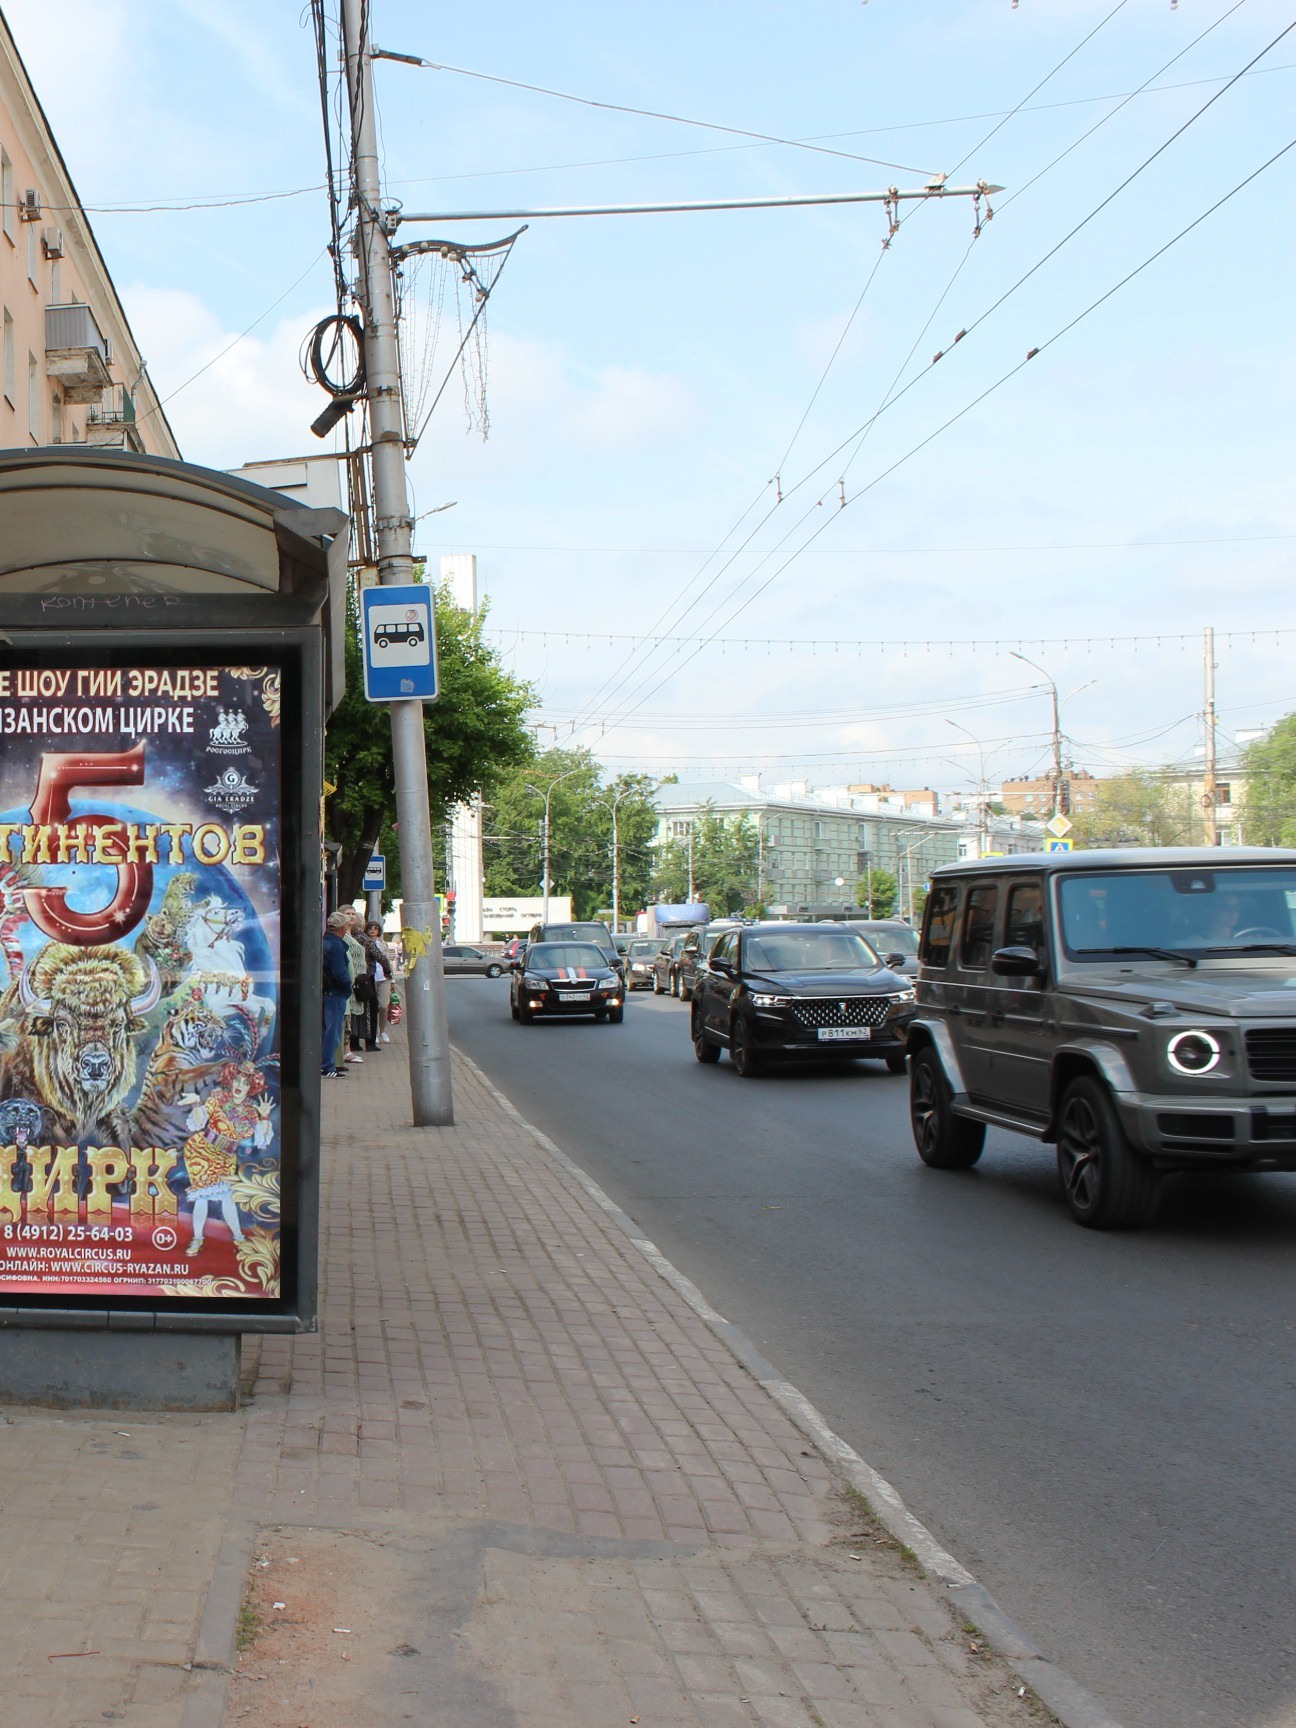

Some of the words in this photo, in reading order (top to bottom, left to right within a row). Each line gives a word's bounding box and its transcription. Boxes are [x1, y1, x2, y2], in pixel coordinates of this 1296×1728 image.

[17, 670, 71, 697] ШОУ
[77, 670, 122, 697] ГИИ
[128, 670, 219, 700] ЭРАДЗЕ
[119, 708, 194, 738] ЦИРКЕ
[24, 740, 153, 945] 5
[4, 1225, 14, 1240] 8
[16, 1223, 63, 1241] (4912)
[68, 1225, 133, 1242] 25-64-03
[156, 1232, 174, 1245] 0+
[6, 1247, 131, 1261] WWW.ROYALCIRCUS.RU
[51, 1261, 189, 1275] WWW.CIRCUS-RYAZAN.RU
